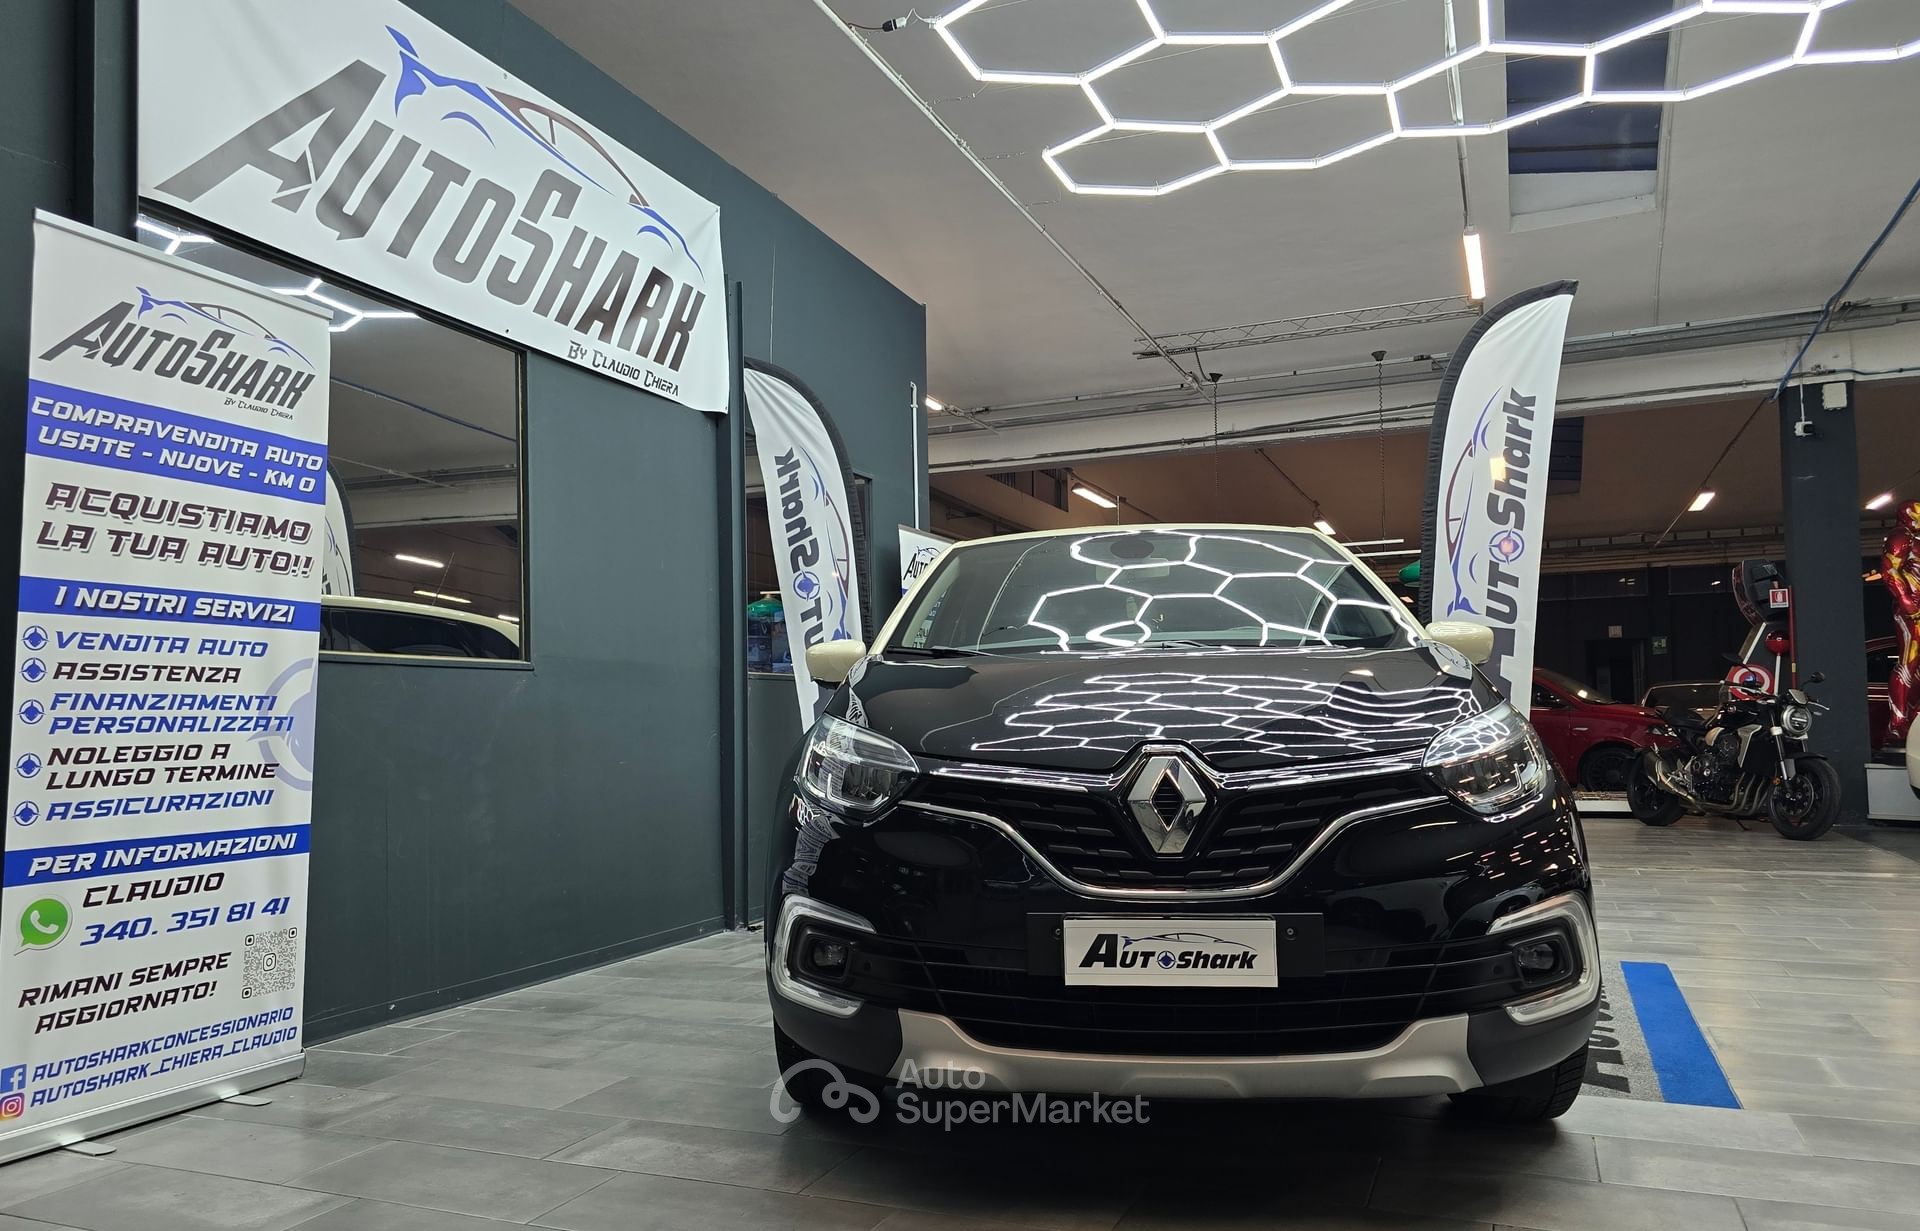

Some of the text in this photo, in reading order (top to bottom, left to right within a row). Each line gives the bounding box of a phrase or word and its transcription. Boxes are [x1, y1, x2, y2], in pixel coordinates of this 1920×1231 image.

[153, 59, 705, 373] AUTOSHARK
[39, 301, 315, 409] AUTOSHARK
[592, 349, 641, 381] CLAUDIO
[643, 370, 679, 396] CHIERA
[32, 396, 323, 471] COMPRAVENDITA AUTO
[38, 425, 136, 459] USATE
[159, 449, 243, 479] NUOVE
[264, 469, 293, 489] KM
[45, 482, 312, 542] ACQUISTIAMO
[37, 522, 313, 575] LA TUA AUTO!!
[55, 586, 296, 623] I NOSTRI SERVIZI
[55, 631, 269, 657] VENDITA AUTO
[53, 662, 242, 683] ASSISTENZA
[50, 693, 278, 711] FINANZIAMENTI
[49, 716, 294, 735] PERSONALIZZATI
[45, 763, 280, 790] LUNGO TERMINE
[47, 744, 231, 766] NOLEGGIO A
[45, 790, 274, 822] ASSICURAZIONI
[28, 833, 297, 877] PER INFORMAZIONI
[83, 872, 225, 908] CLAUDIO
[167, 907, 218, 933] 351
[226, 902, 256, 923] 81
[261, 897, 290, 916] 41
[18, 952, 232, 1008] RIMANI SEMPRE
[34, 981, 218, 1034] AGGIORNATO!
[32, 1007, 294, 1083] AUTOSHARKCONCESSIONARIO
